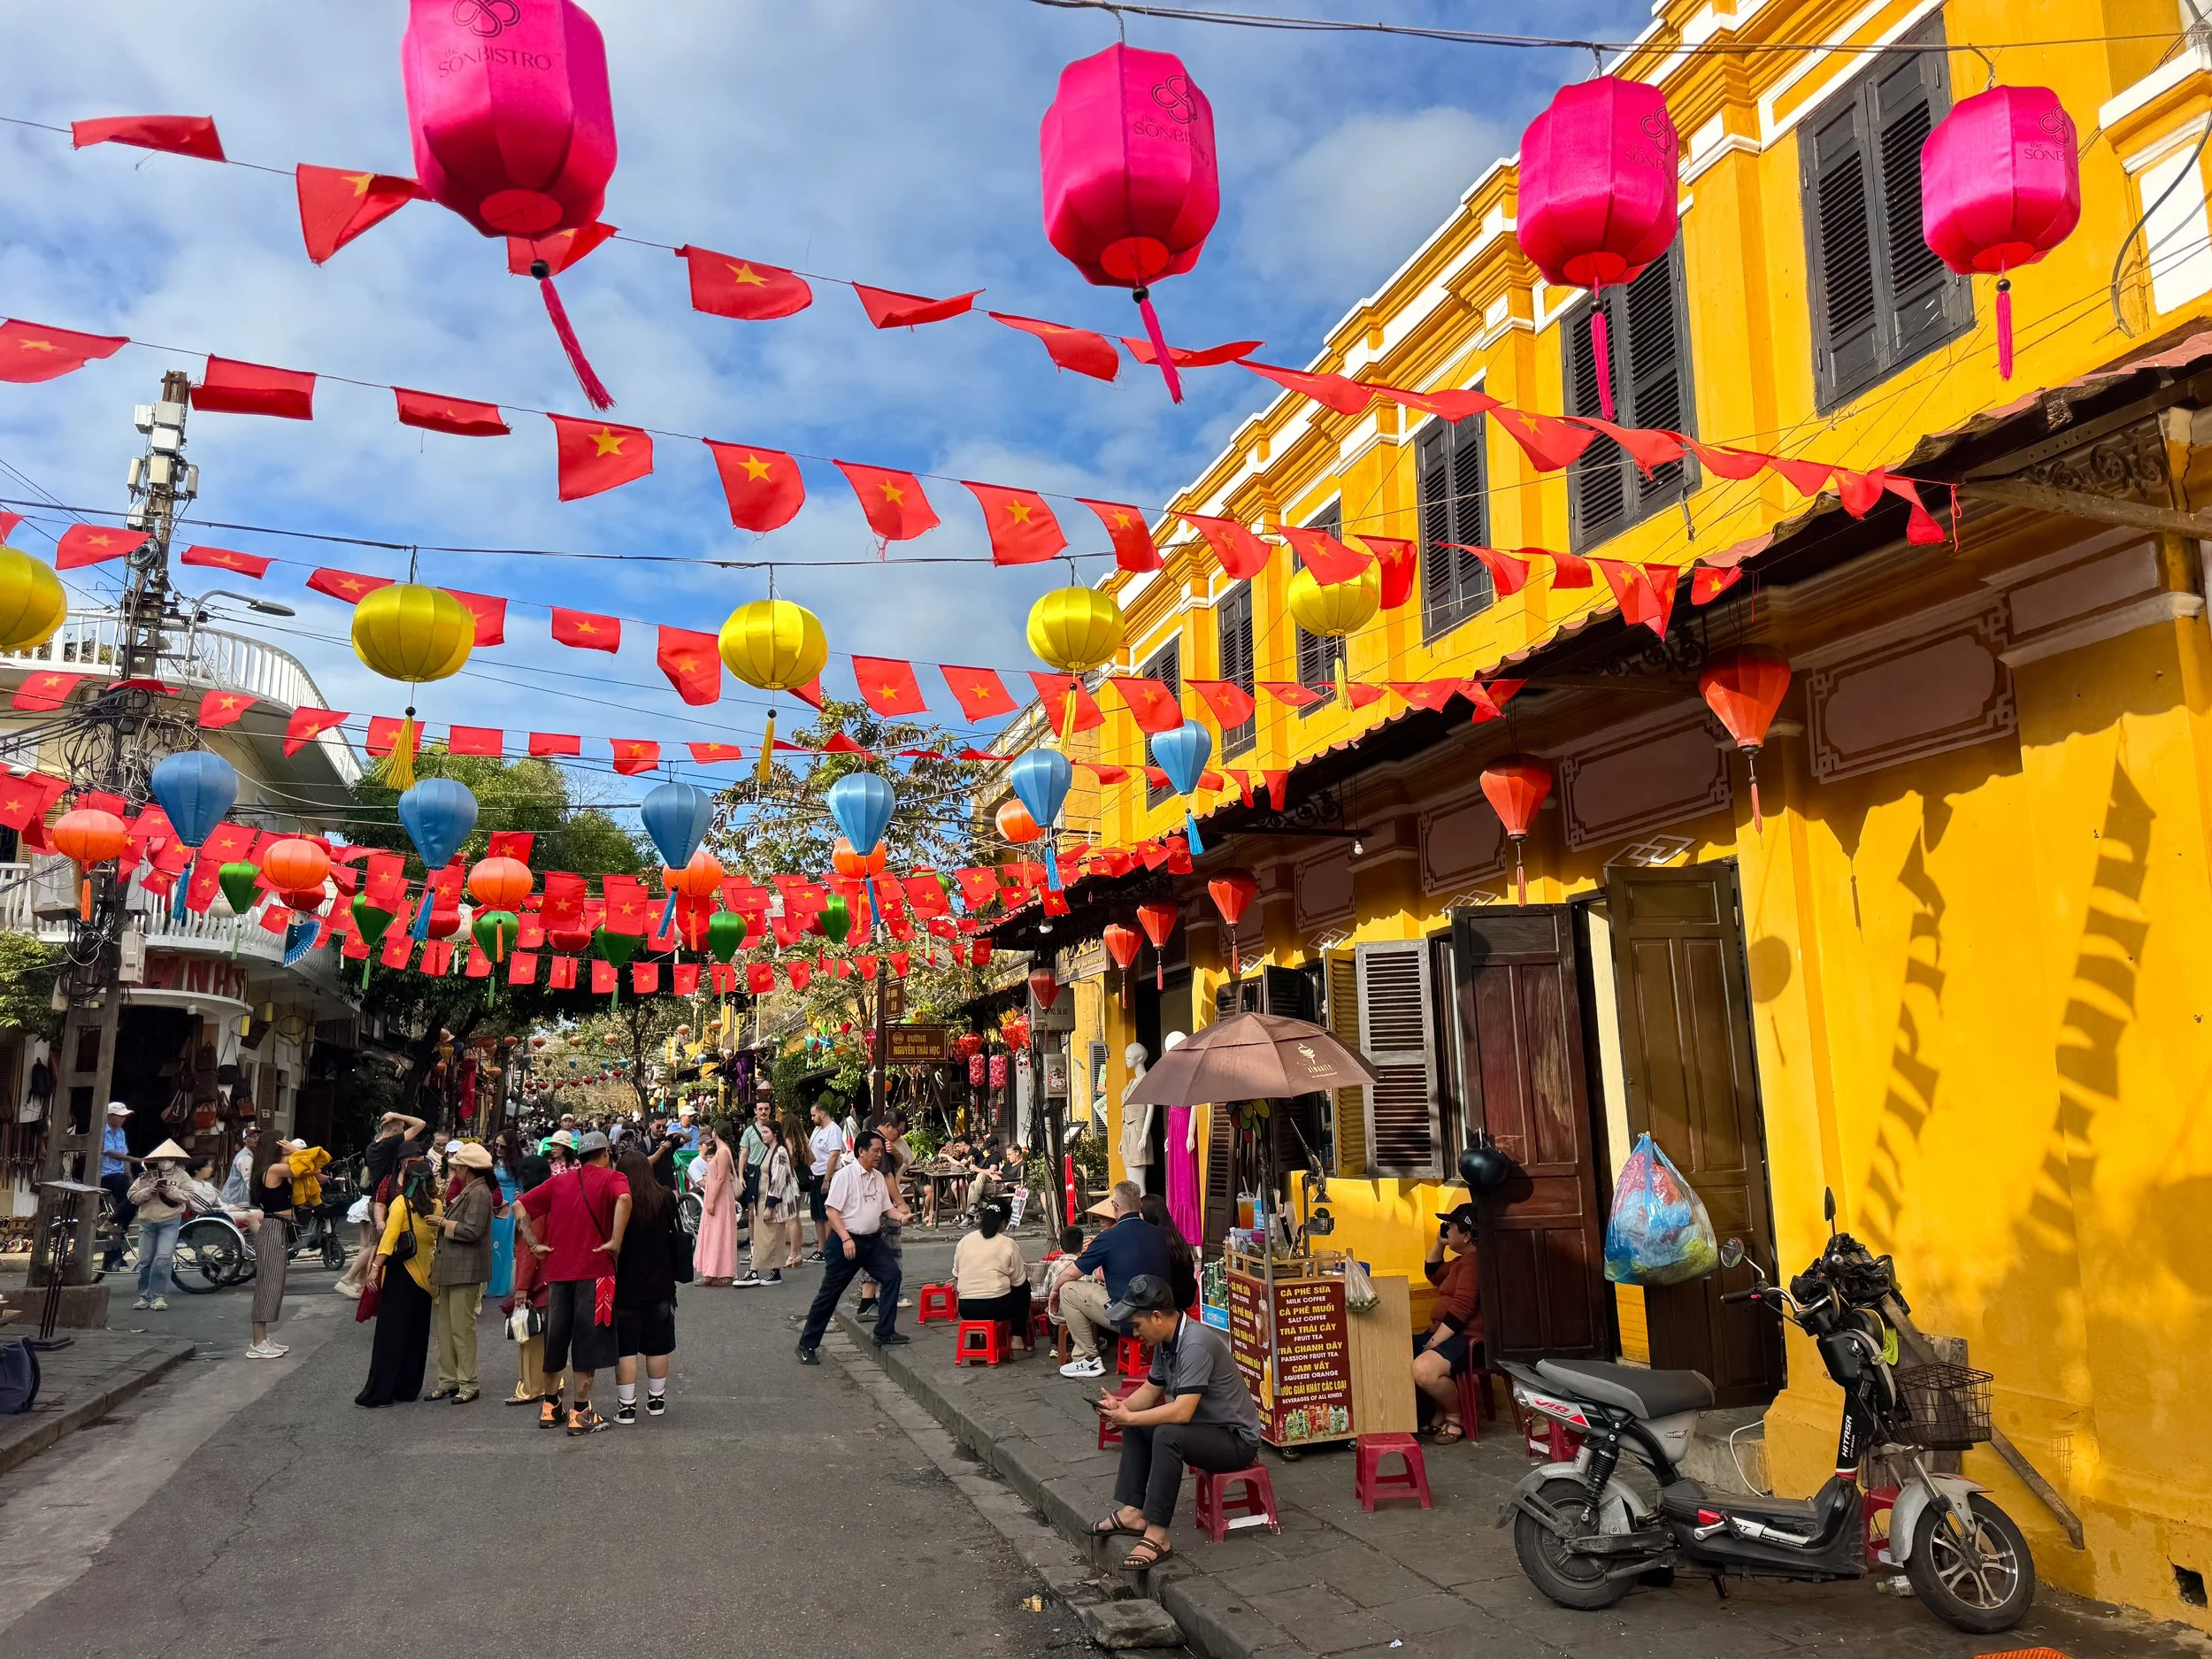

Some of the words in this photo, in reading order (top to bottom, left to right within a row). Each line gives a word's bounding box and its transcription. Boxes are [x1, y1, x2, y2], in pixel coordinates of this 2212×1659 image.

[439, 46, 552, 78] SONBISTRO
[929, 1045, 941, 1056] HỌC
[1280, 1288, 1292, 1297] CÀ
[1294, 1286, 1311, 1296] PHÊ
[1313, 1285, 1331, 1294] SỮA
[1279, 1307, 1291, 1317] CÀ
[1293, 1305, 1310, 1316] PHÊ
[1312, 1302, 1334, 1313] MUỐI
[1279, 1325, 1296, 1335] TRÀ
[1298, 1324, 1317, 1334] TRÁI
[1319, 1322, 1336, 1332] CÂY
[1294, 1343, 1324, 1354] CHANH
[1325, 1340, 1342, 1350] DÂY
[1292, 1363, 1312, 1373] CAM
[1283, 1372, 1310, 1382] SQUEEZE
[1321, 1380, 1333, 1392] CÁC
[1333, 1379, 1347, 1392] LOẠI
[1282, 1395, 1310, 1404] BEVERAGES
[1841, 1415, 1853, 1458] HITASA
